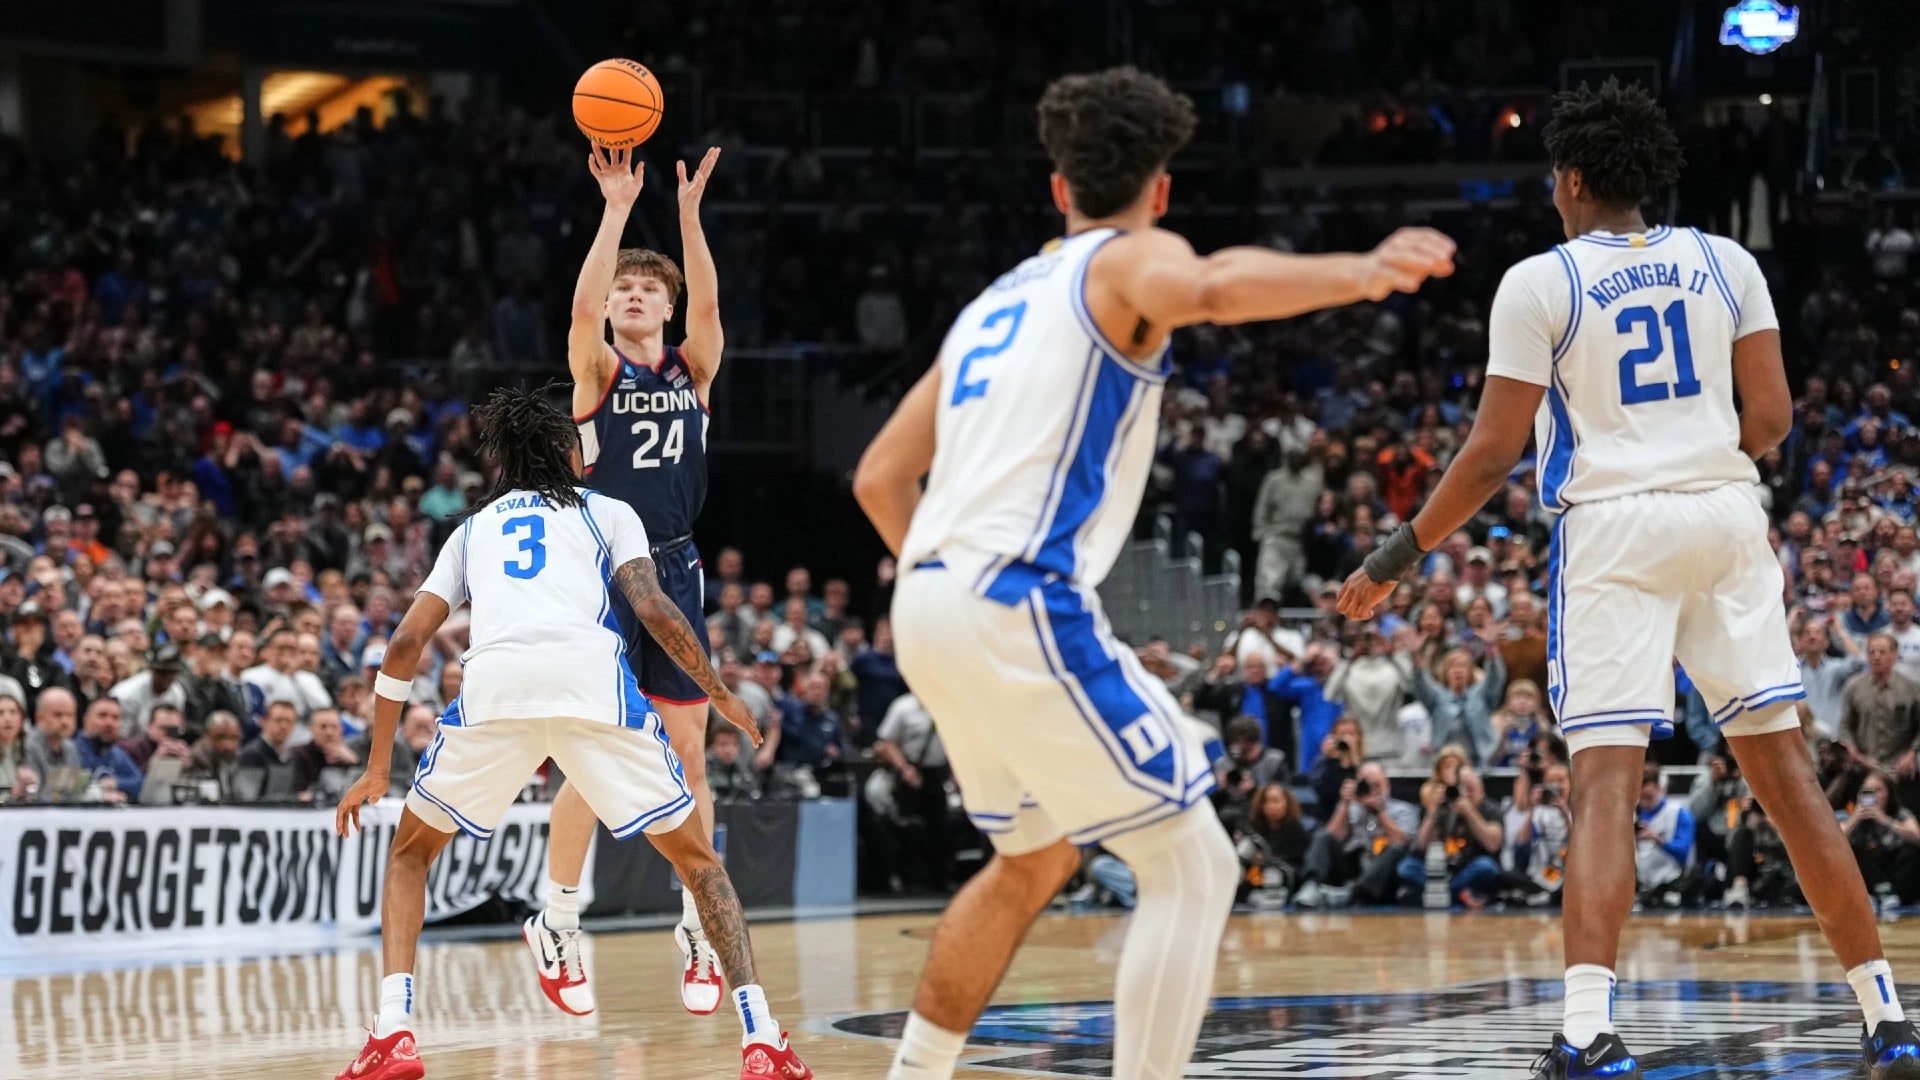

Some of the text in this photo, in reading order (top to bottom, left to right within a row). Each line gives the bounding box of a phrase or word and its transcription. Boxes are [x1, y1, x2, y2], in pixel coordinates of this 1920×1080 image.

[1587, 263, 1709, 310] NGONGBA II
[951, 301, 1027, 406] 2
[1615, 299, 1701, 405] 21
[612, 390, 698, 414] UCONN
[631, 419, 684, 469] 24
[502, 514, 546, 579] 3
[13, 822, 549, 935] GEORGETOWN UVERSIT
